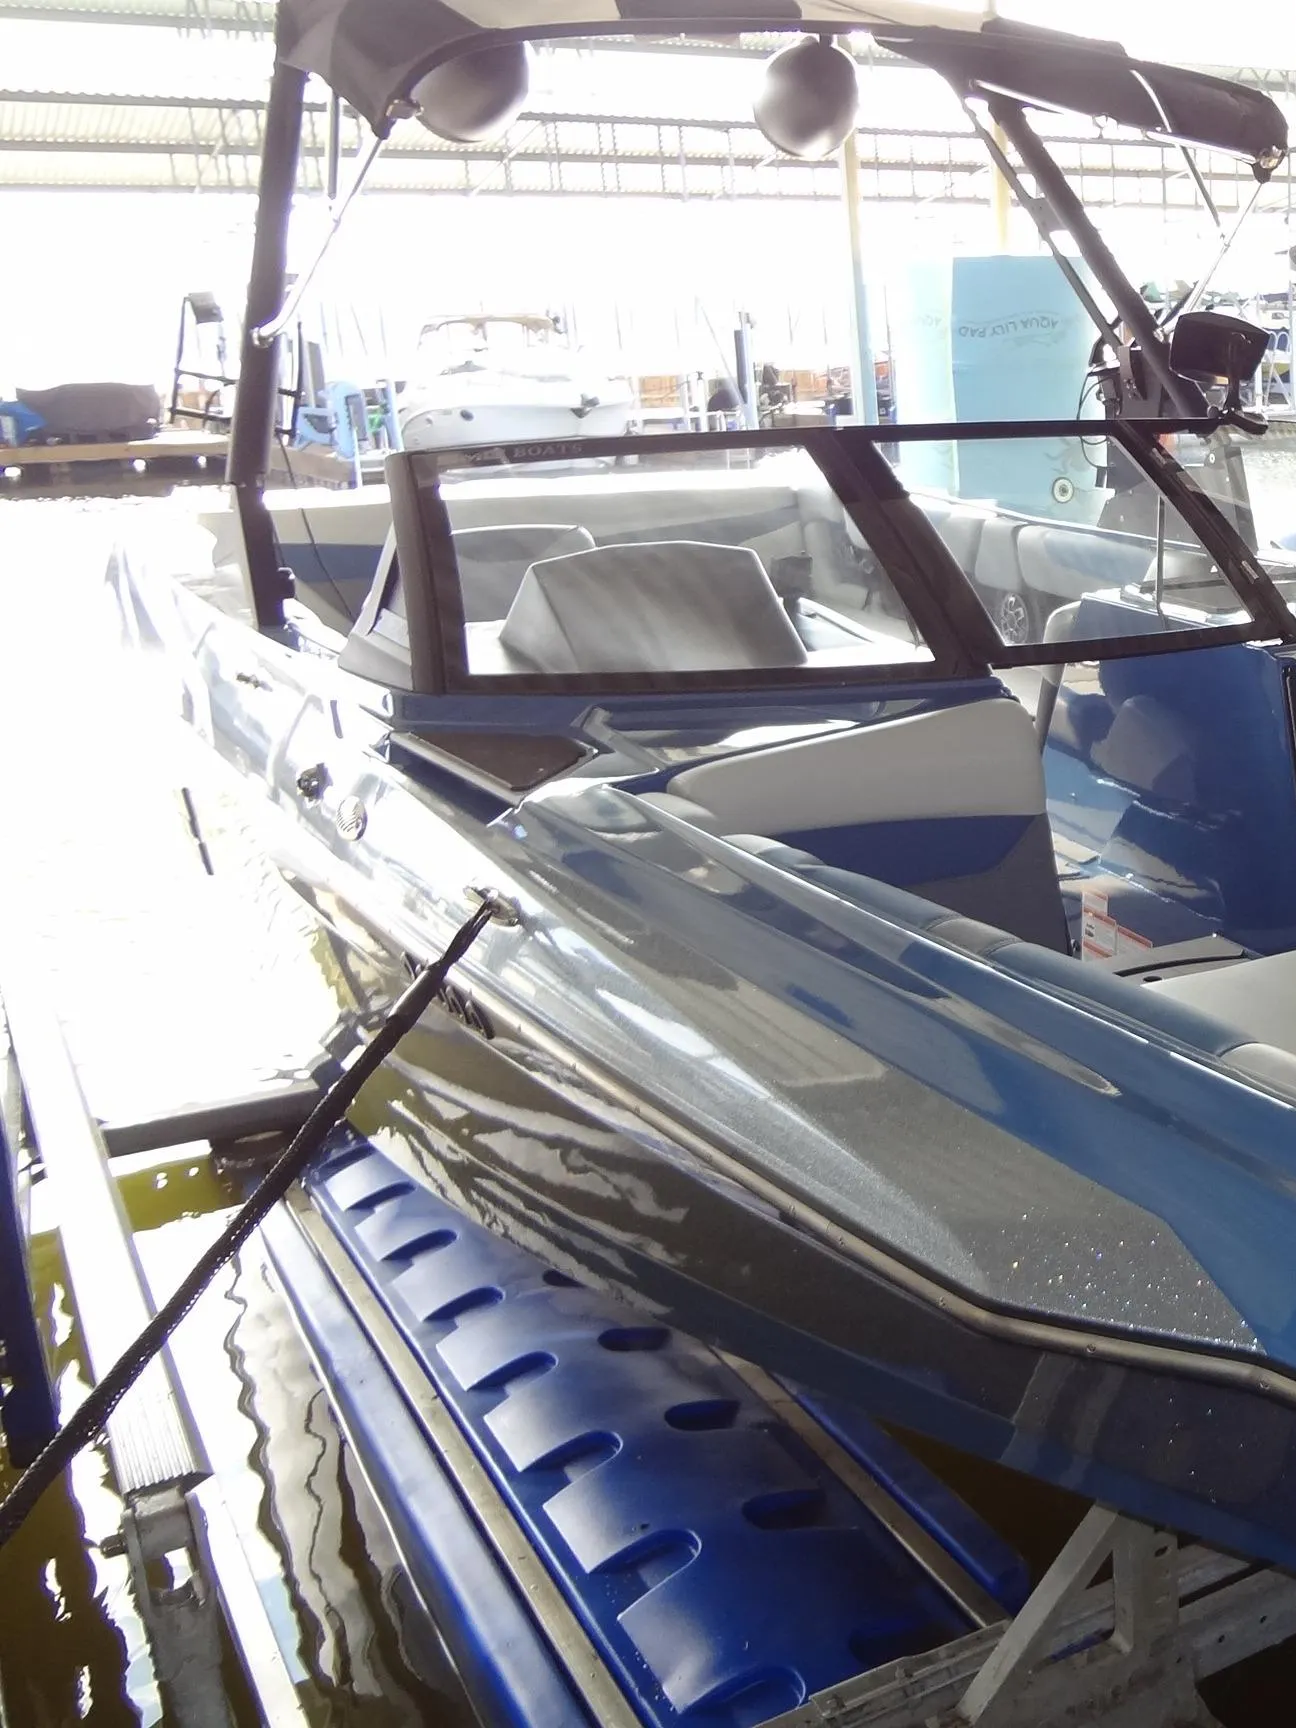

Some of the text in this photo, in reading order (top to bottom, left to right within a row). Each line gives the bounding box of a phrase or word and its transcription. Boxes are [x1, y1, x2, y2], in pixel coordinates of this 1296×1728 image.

[958, 316, 1059, 338] AQUA LILY PAD
[513, 443, 583, 458] BOATS
